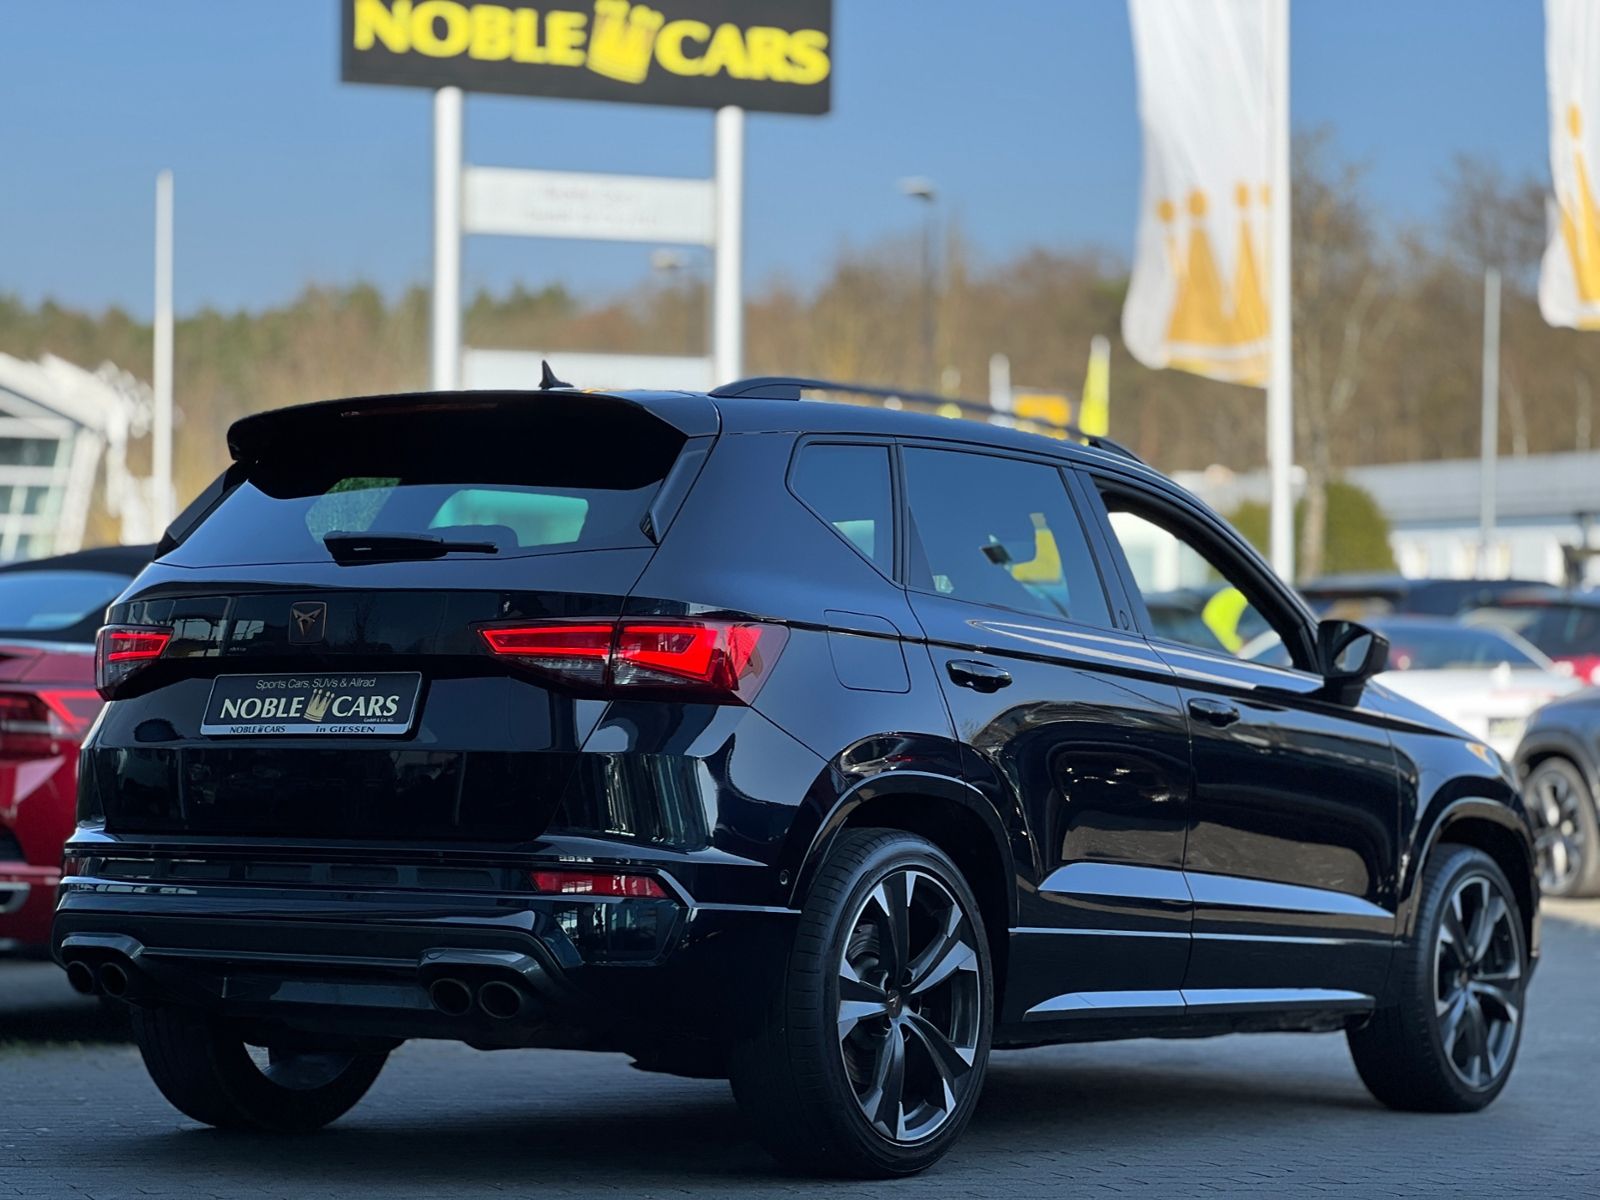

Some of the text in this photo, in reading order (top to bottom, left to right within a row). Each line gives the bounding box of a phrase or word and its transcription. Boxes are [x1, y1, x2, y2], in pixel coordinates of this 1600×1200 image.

[353, 0, 832, 85] NOBLE CARS
[256, 680, 286, 690] Sports
[312, 678, 338, 688] SUVs
[339, 679, 347, 688] &
[348, 677, 377, 688] Allrad
[220, 695, 400, 719] NOBLE CARS
[230, 725, 286, 734] NOBLE CARS
[316, 725, 376, 733] in GIESSEN
